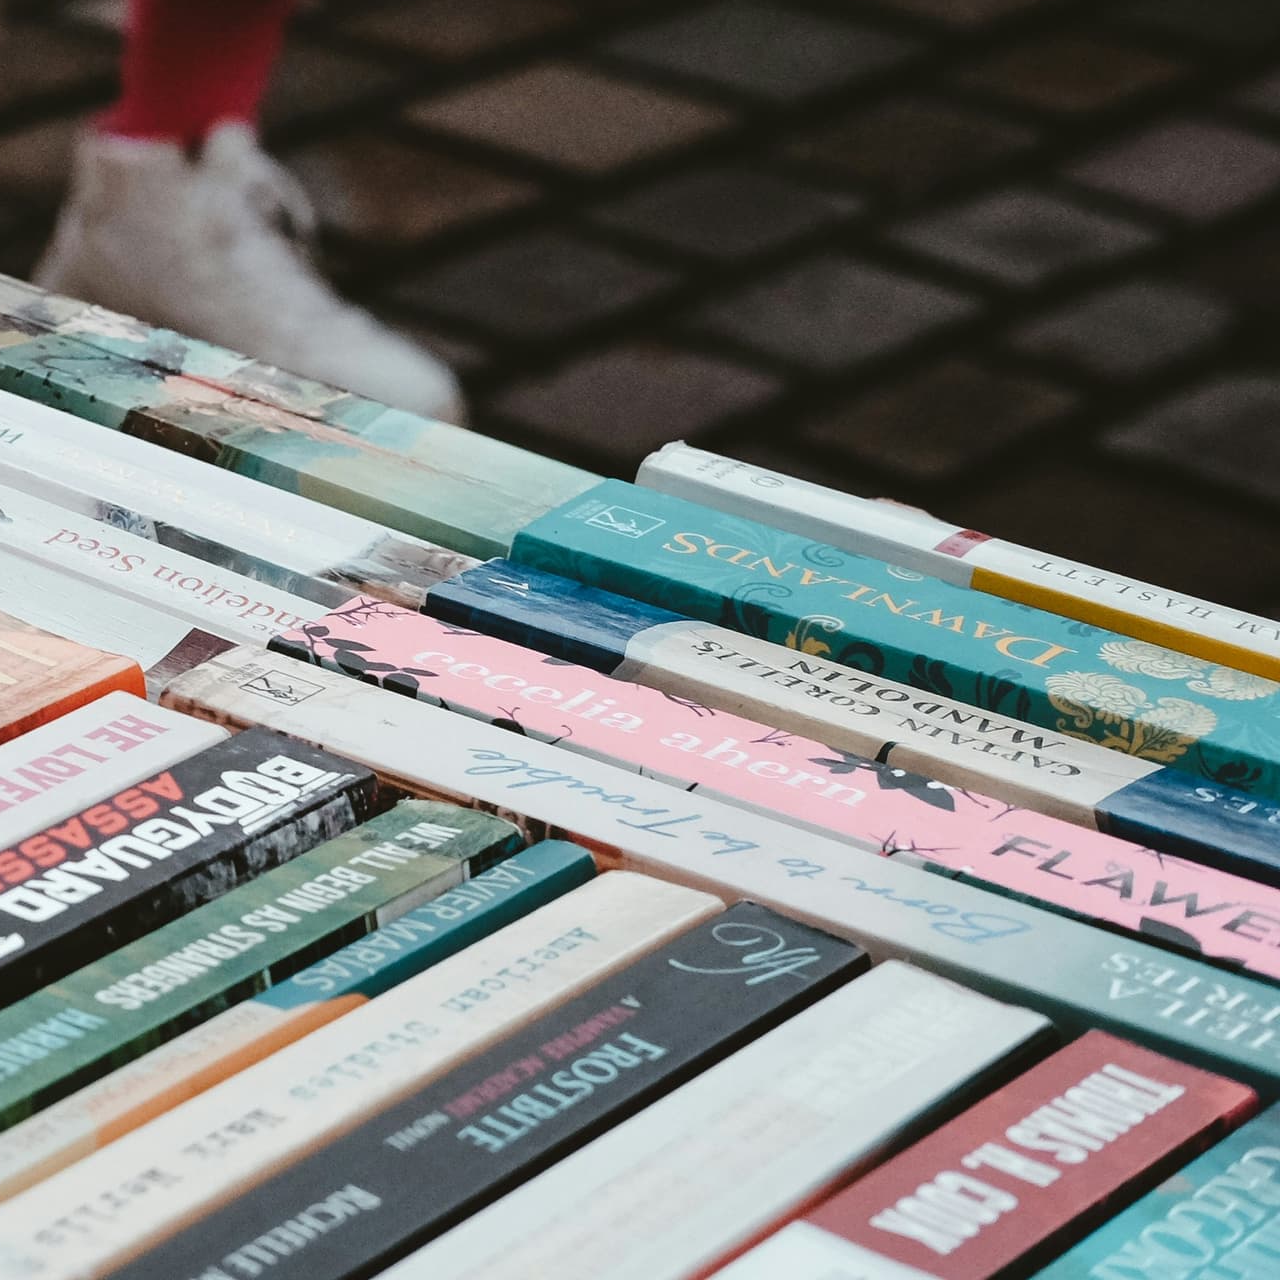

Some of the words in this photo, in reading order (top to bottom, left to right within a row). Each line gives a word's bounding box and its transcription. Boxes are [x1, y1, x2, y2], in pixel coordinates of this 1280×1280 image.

[44, 527, 145, 574] Seed
[662, 531, 1080, 670] DAWNLANDS
[1031, 559, 1216, 622] HASLETT
[689, 638, 883, 717] CORELLI'S
[787, 656, 1068, 752] MANDOLIN
[411, 648, 645, 736] cecelia
[657, 724, 869, 808] ahern
[897, 717, 1084, 780] CAPTAIN
[462, 746, 704, 842] Trouble
[348, 844, 420, 871] ALL
[395, 821, 464, 850] WE
[700, 829, 760, 857] be
[778, 855, 830, 881] to
[241, 901, 303, 933] AS
[276, 864, 377, 914] BEGIN
[415, 857, 537, 922] JAVIER
[838, 873, 1034, 946] Born
[991, 833, 1280, 948] FLAWE
[94, 923, 266, 1010] STRANGERS
[291, 916, 437, 993] MARÍAS
[439, 925, 600, 1015] American
[288, 1020, 440, 1100] Studies
[455, 1031, 672, 1152] FROSTBITE
[1003, 1062, 1187, 1164] THOMAS
[961, 1140, 1062, 1189] H.
[221, 1183, 383, 1278] RICHELLE
[868, 1169, 1020, 1256] COOK
